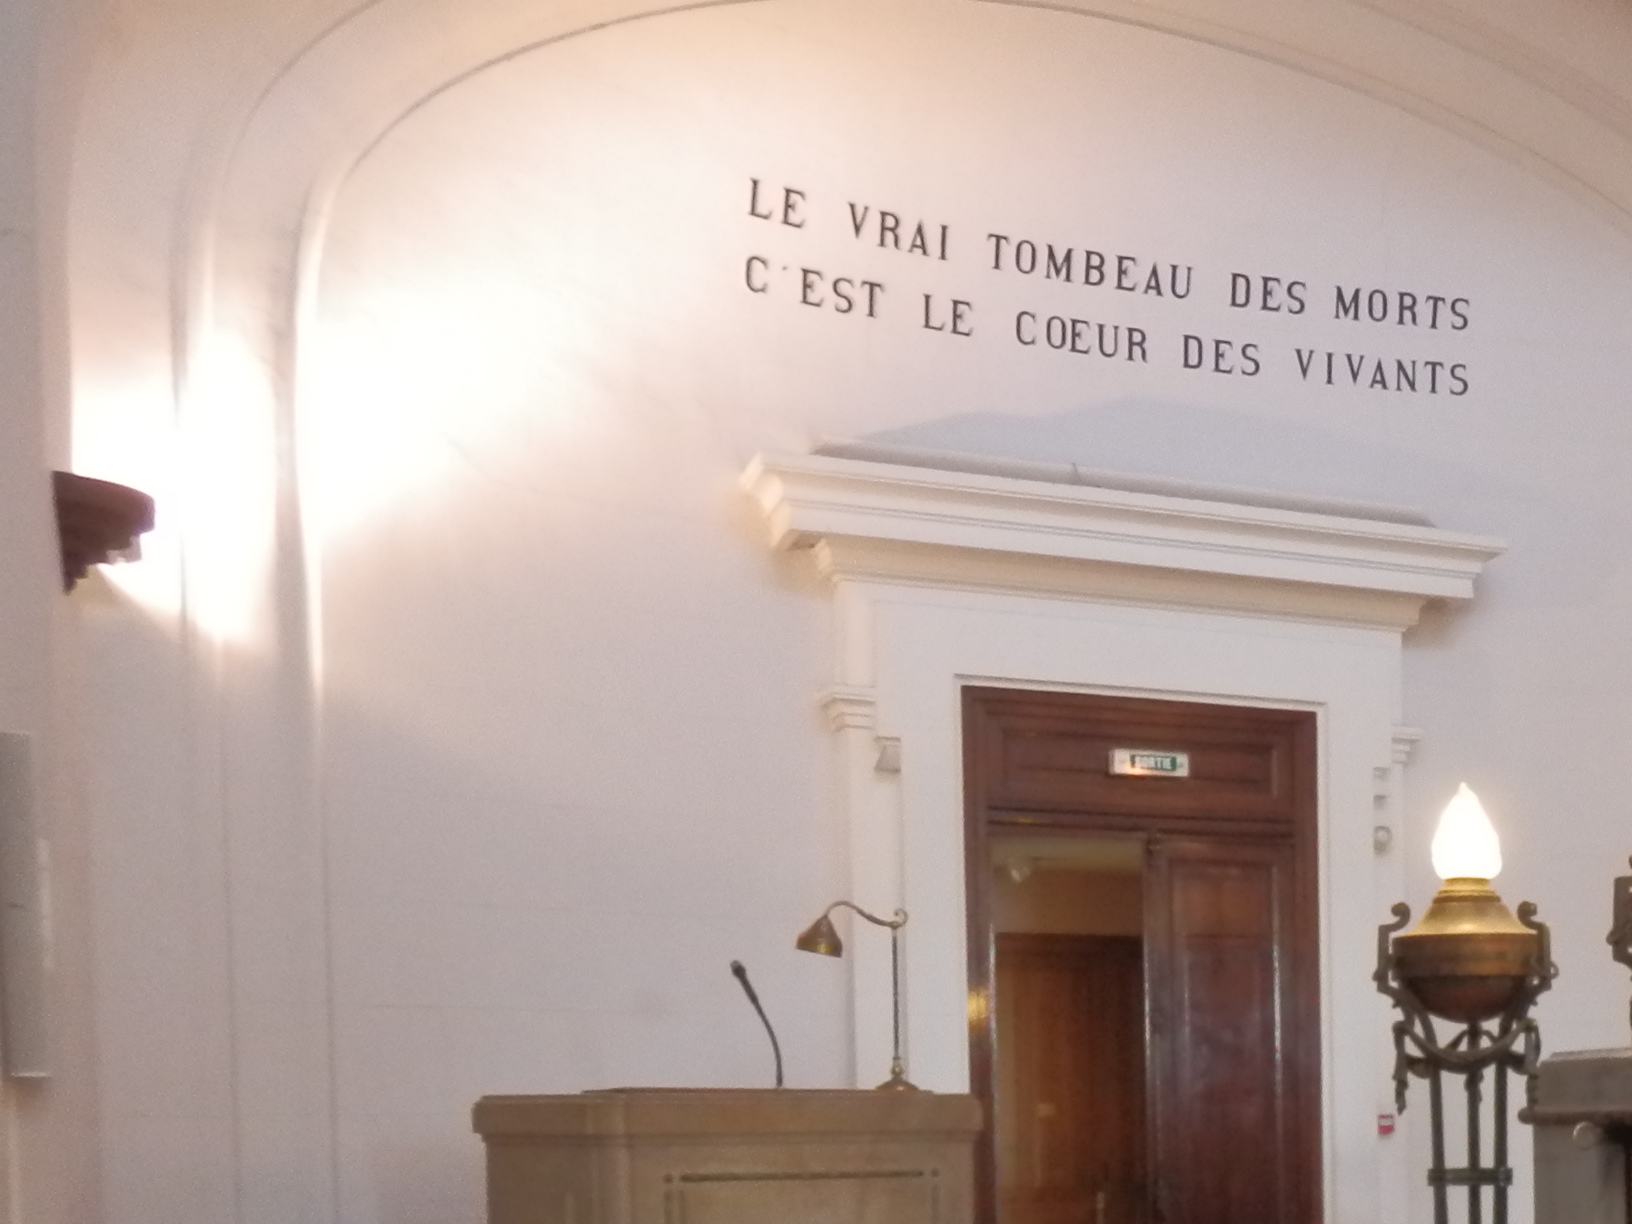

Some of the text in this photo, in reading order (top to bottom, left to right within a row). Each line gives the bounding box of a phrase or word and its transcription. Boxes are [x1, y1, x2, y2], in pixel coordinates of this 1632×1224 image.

[745, 256, 884, 319] C'EST
[922, 294, 973, 337] LE
[1183, 335, 1261, 377] DES
[1294, 349, 1469, 396] VIVANTS
[748, 178, 1470, 331] LE VRAI TOMBEAU DES MORTS
